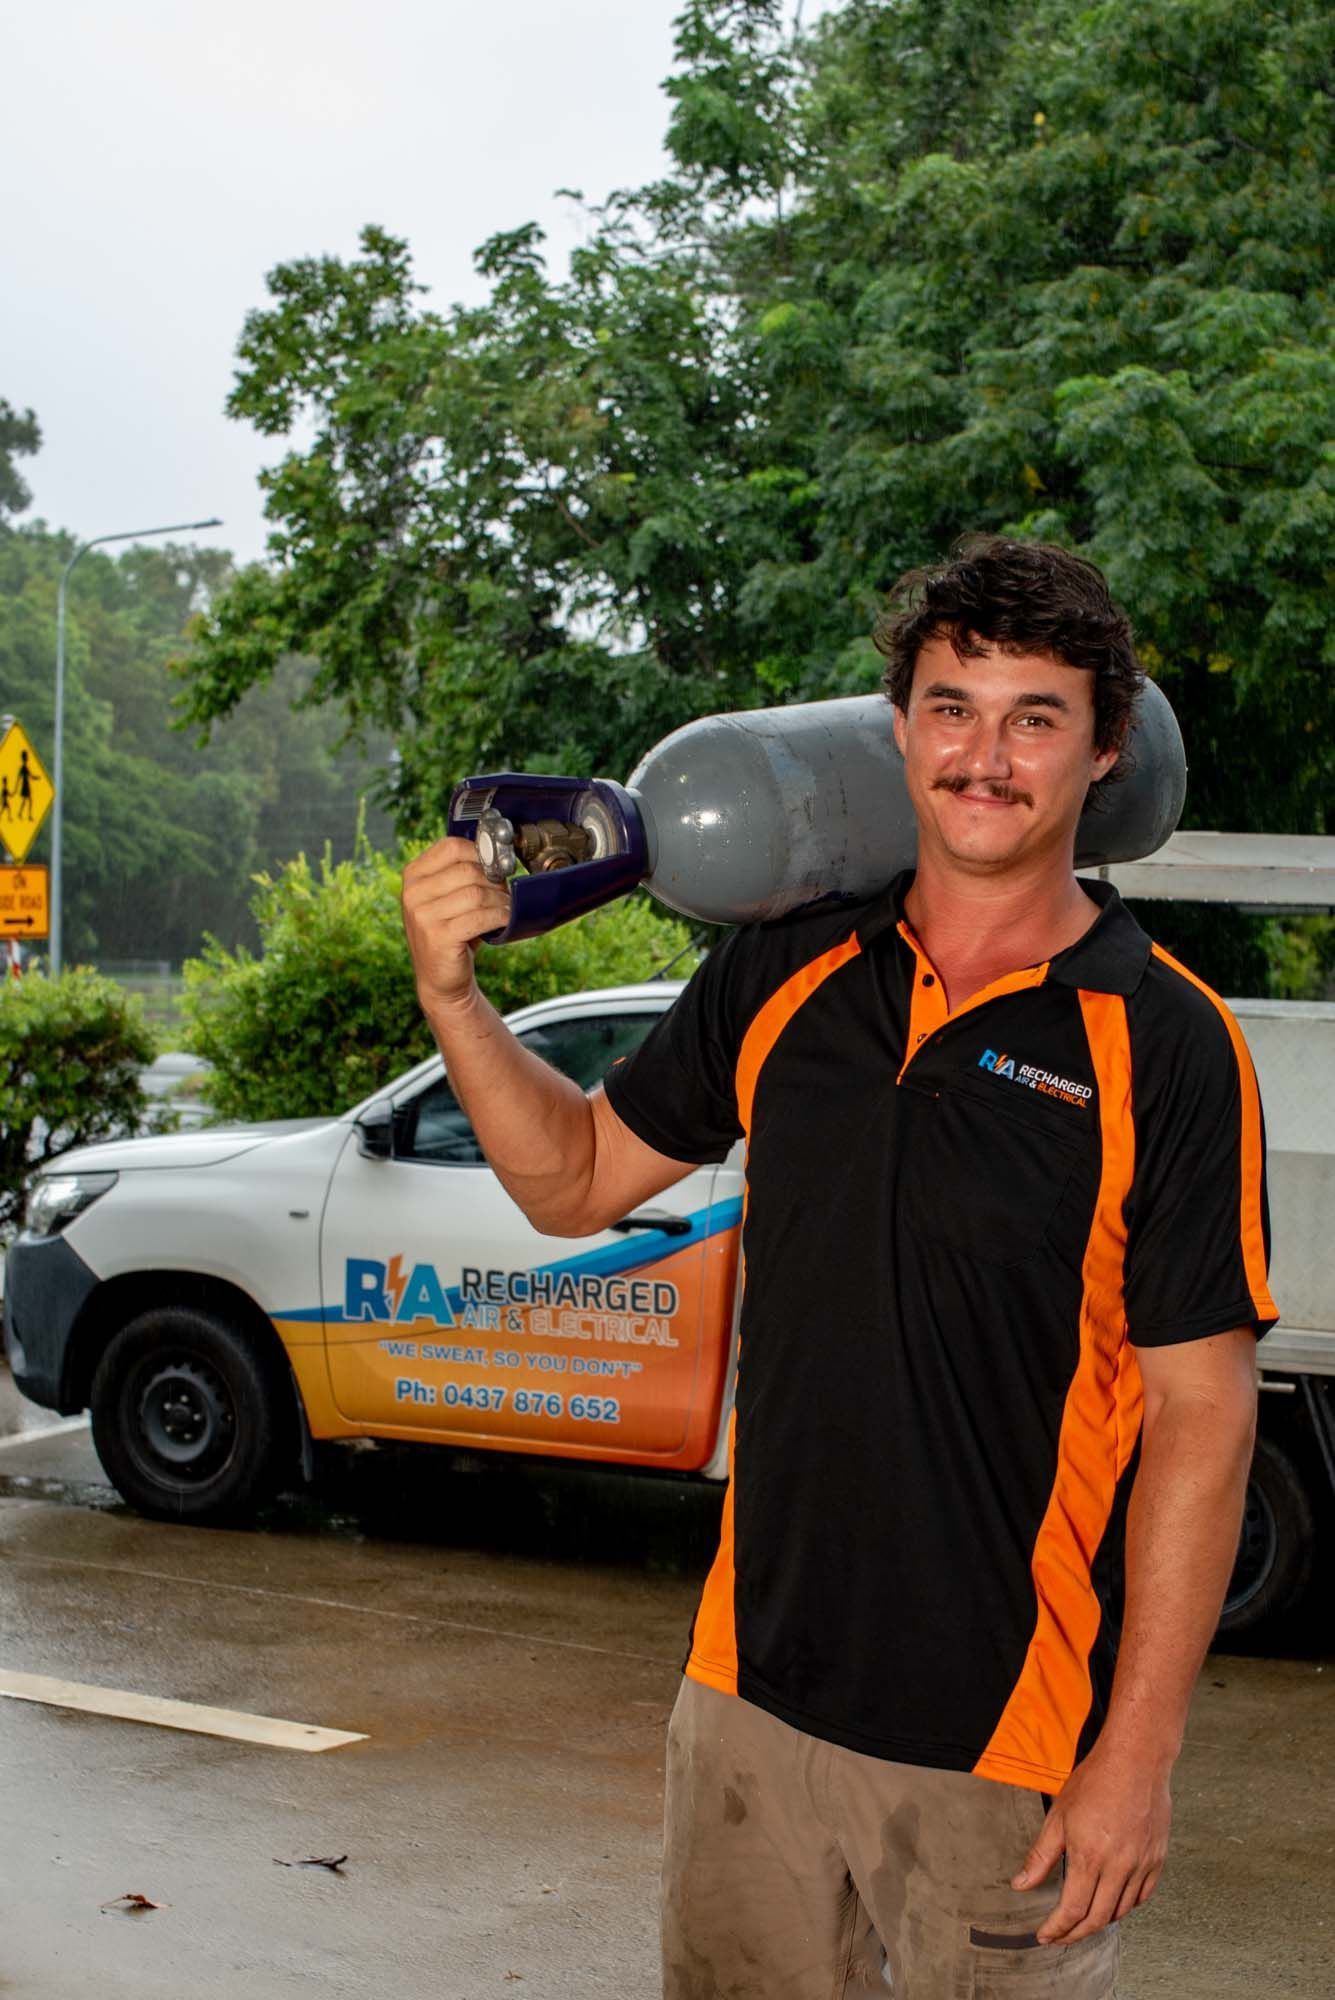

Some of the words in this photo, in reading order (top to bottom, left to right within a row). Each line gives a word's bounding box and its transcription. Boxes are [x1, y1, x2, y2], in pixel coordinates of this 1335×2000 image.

[1015, 1075, 1029, 1085] AIR
[1029, 1080, 1037, 1089] &
[1037, 1082, 1087, 1108] ELECTRICAL
[1019, 1064, 1093, 1099] RECHARGED
[461, 1268, 678, 1316] RECHARGED
[461, 1305, 500, 1331] AIR
[507, 1310, 523, 1332] &
[530, 1310, 678, 1346] ELECTRICAL
[422, 1344, 488, 1367] SWEAT,
[494, 1351, 520, 1366] SO
[525, 1354, 566, 1371] YOU
[396, 1379, 436, 1403] Ph:
[444, 1385, 504, 1411] 0437
[514, 1391, 562, 1417] 876
[569, 1397, 620, 1424] 652
